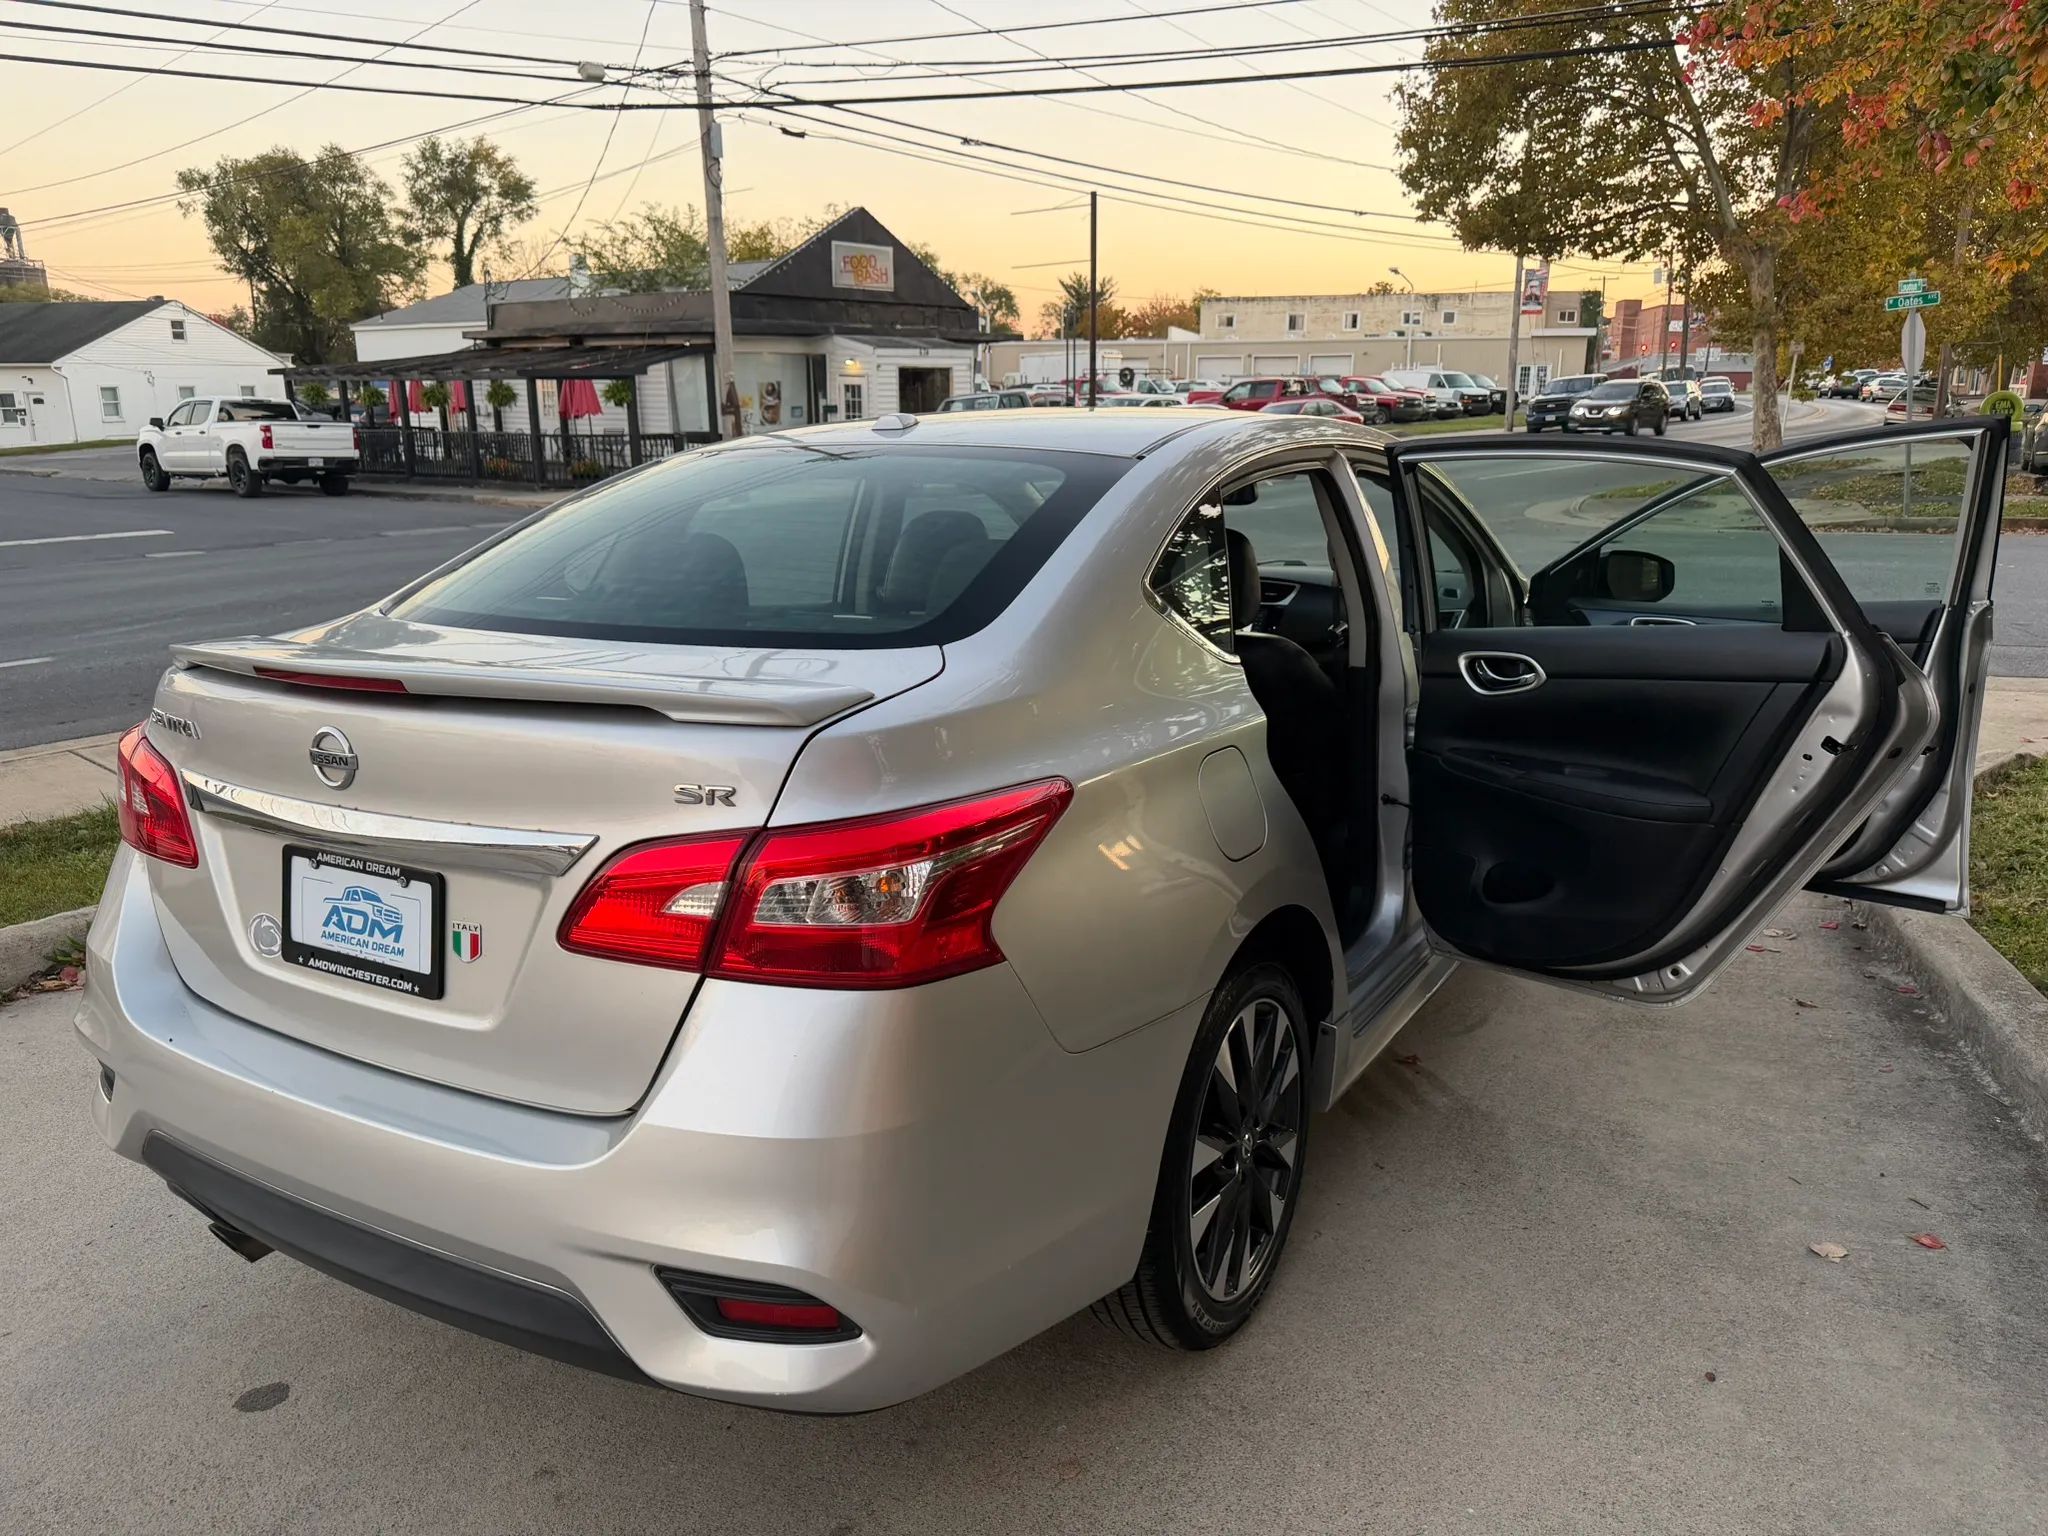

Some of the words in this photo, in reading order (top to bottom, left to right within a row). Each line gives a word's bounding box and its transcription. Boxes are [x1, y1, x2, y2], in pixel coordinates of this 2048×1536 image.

[842, 255, 877, 270] FOOD
[855, 266, 889, 284] BASH
[1897, 297, 1923, 307] Oates
[311, 752, 349, 766] NISSAN
[674, 784, 737, 807] SR
[316, 852, 364, 870] AMERICAN
[366, 861, 401, 877] DREAM
[322, 905, 404, 944] ADM
[452, 923, 479, 932] ITALY
[321, 930, 369, 949] AMERICAN
[371, 941, 405, 957] DREAM
[308, 958, 412, 992] AMDWINCHESTER.COM
